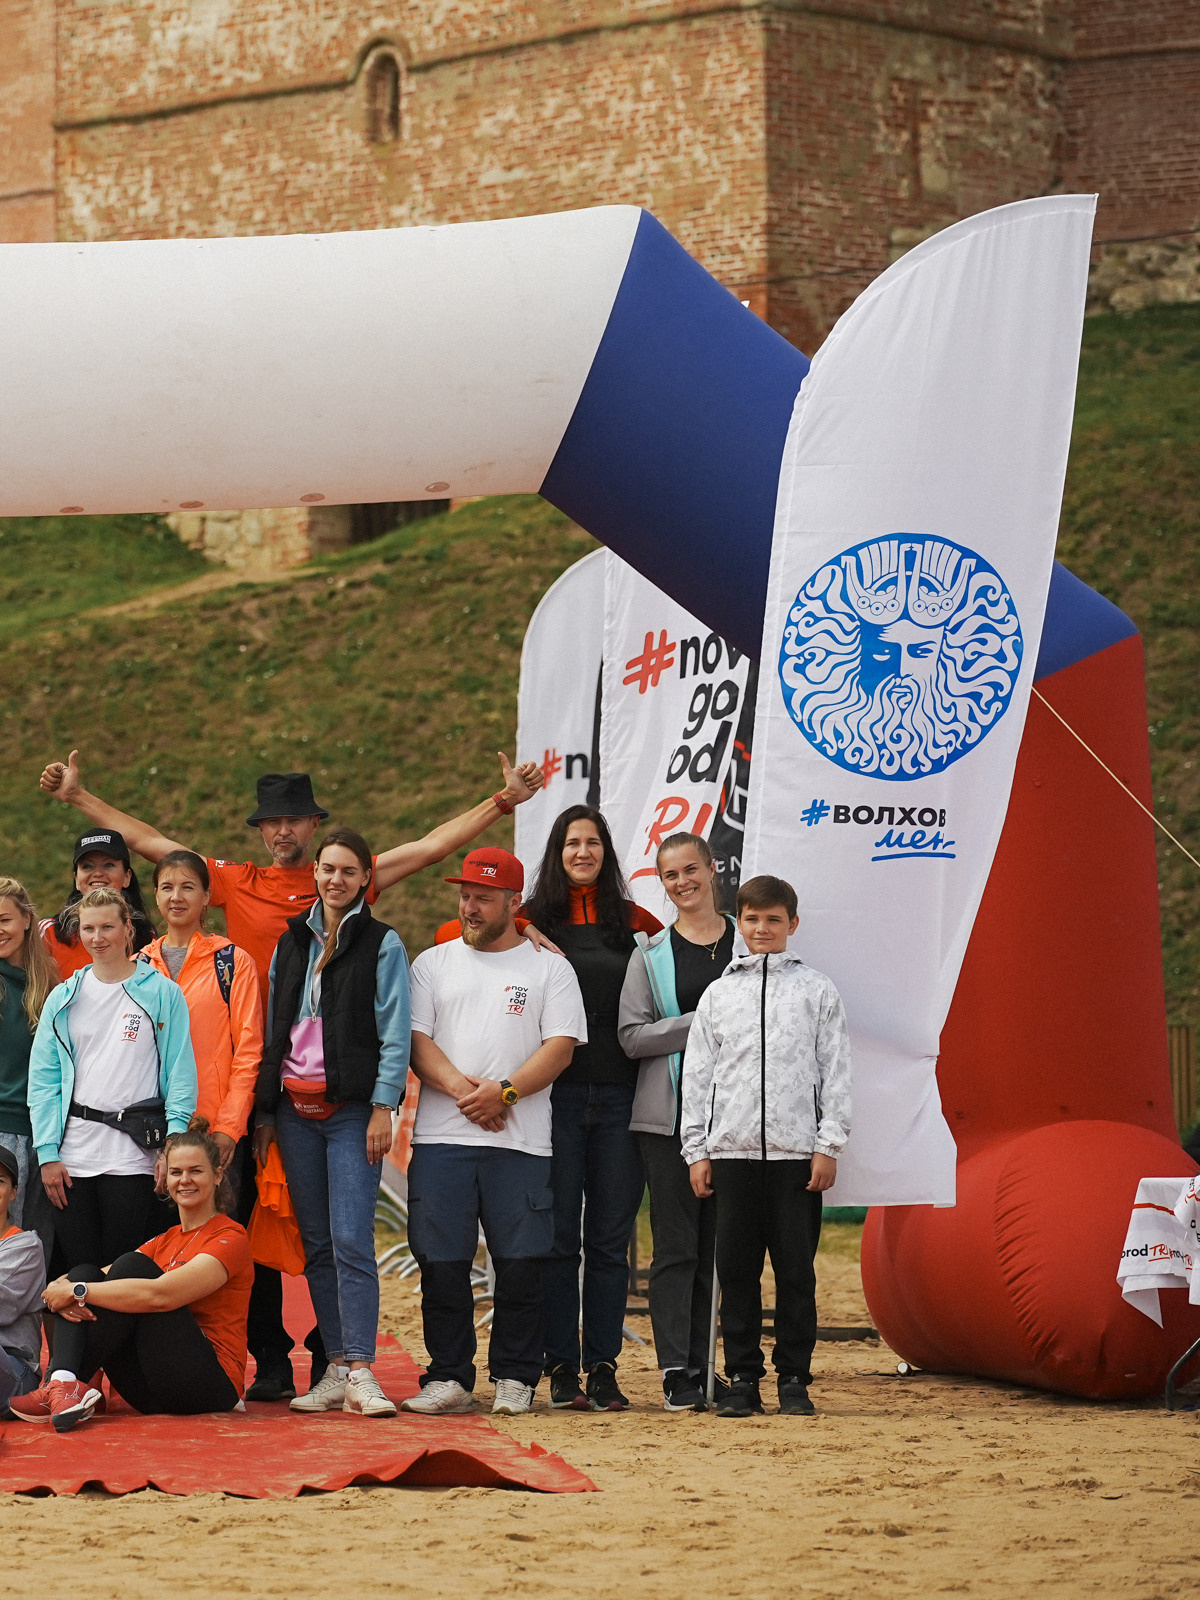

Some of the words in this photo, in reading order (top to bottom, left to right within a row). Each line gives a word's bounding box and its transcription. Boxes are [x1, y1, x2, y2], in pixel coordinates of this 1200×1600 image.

[682, 679, 740, 740] go
[800, 799, 947, 828] #ВОЛХОВ
[509, 998, 526, 1006] rod
[515, 991, 527, 999] go
